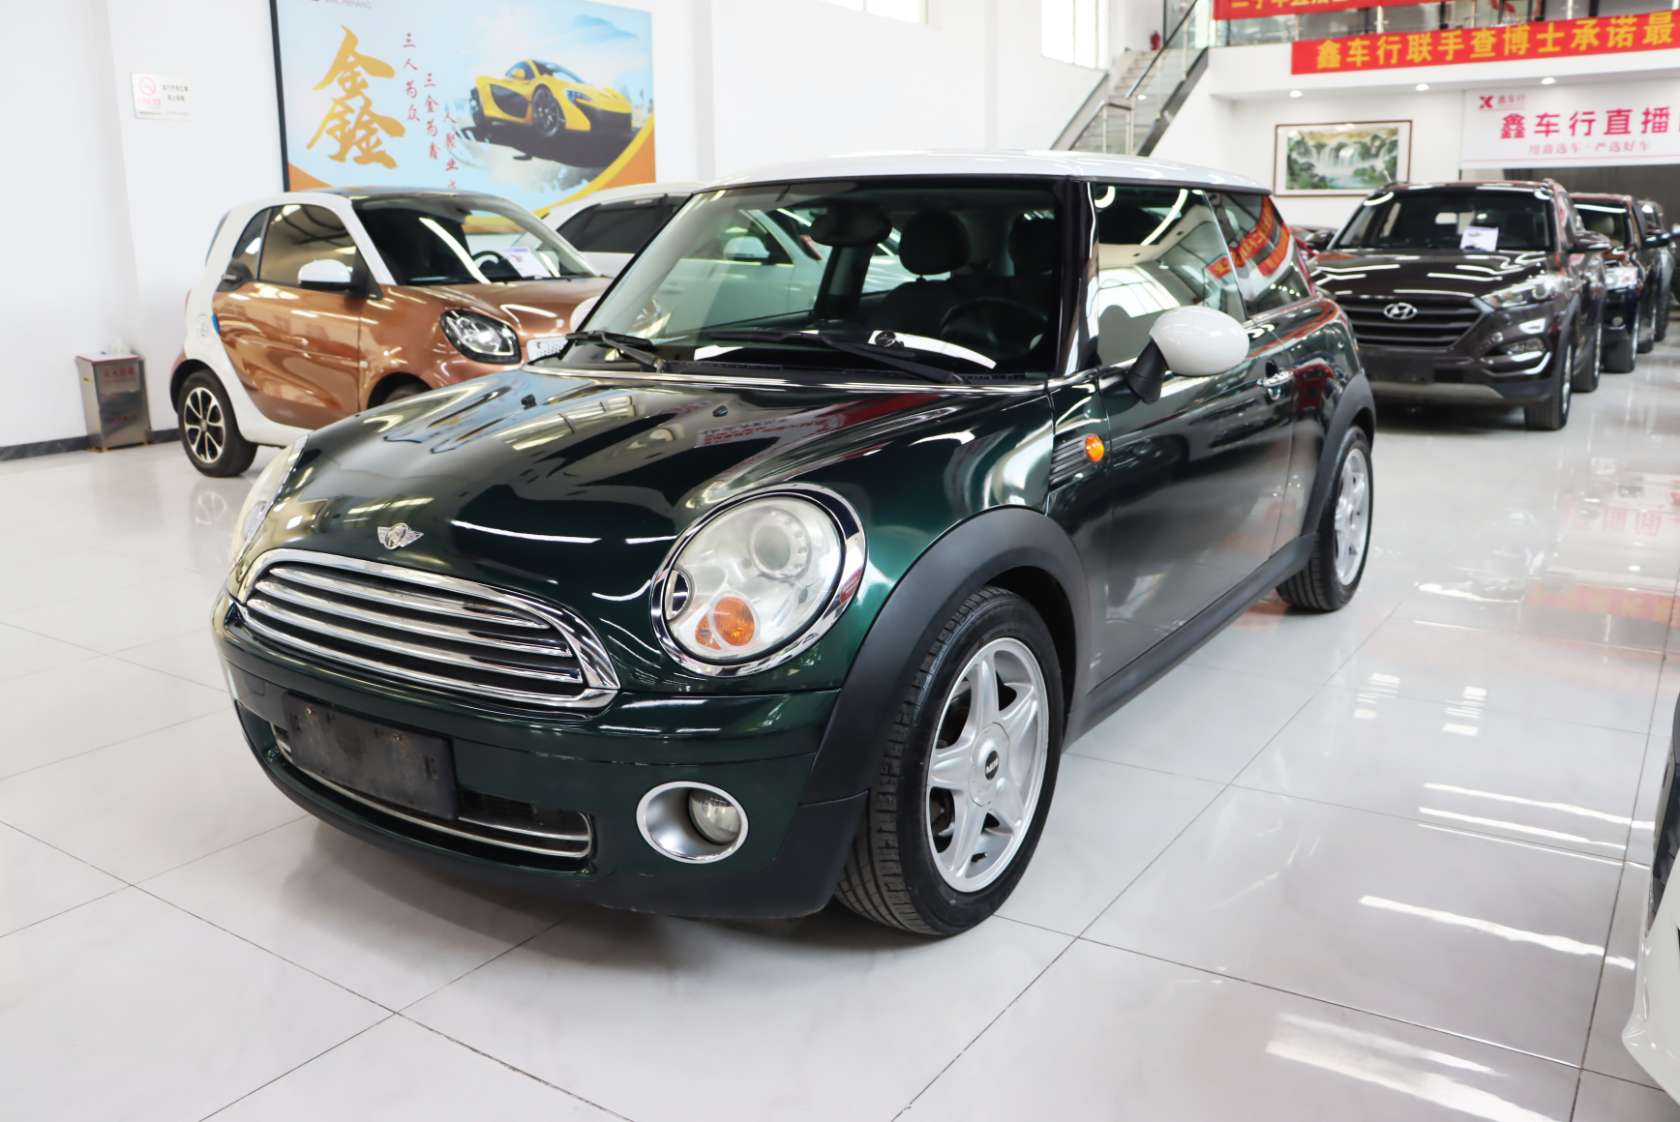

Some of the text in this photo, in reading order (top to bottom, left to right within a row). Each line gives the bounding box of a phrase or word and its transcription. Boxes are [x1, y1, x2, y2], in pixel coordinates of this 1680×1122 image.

[1315, 11, 1673, 70] 鑫车行联手查博士承诺最
[307, 24, 406, 169] 鑫
[1500, 106, 1680, 139] 鑫车行直播
